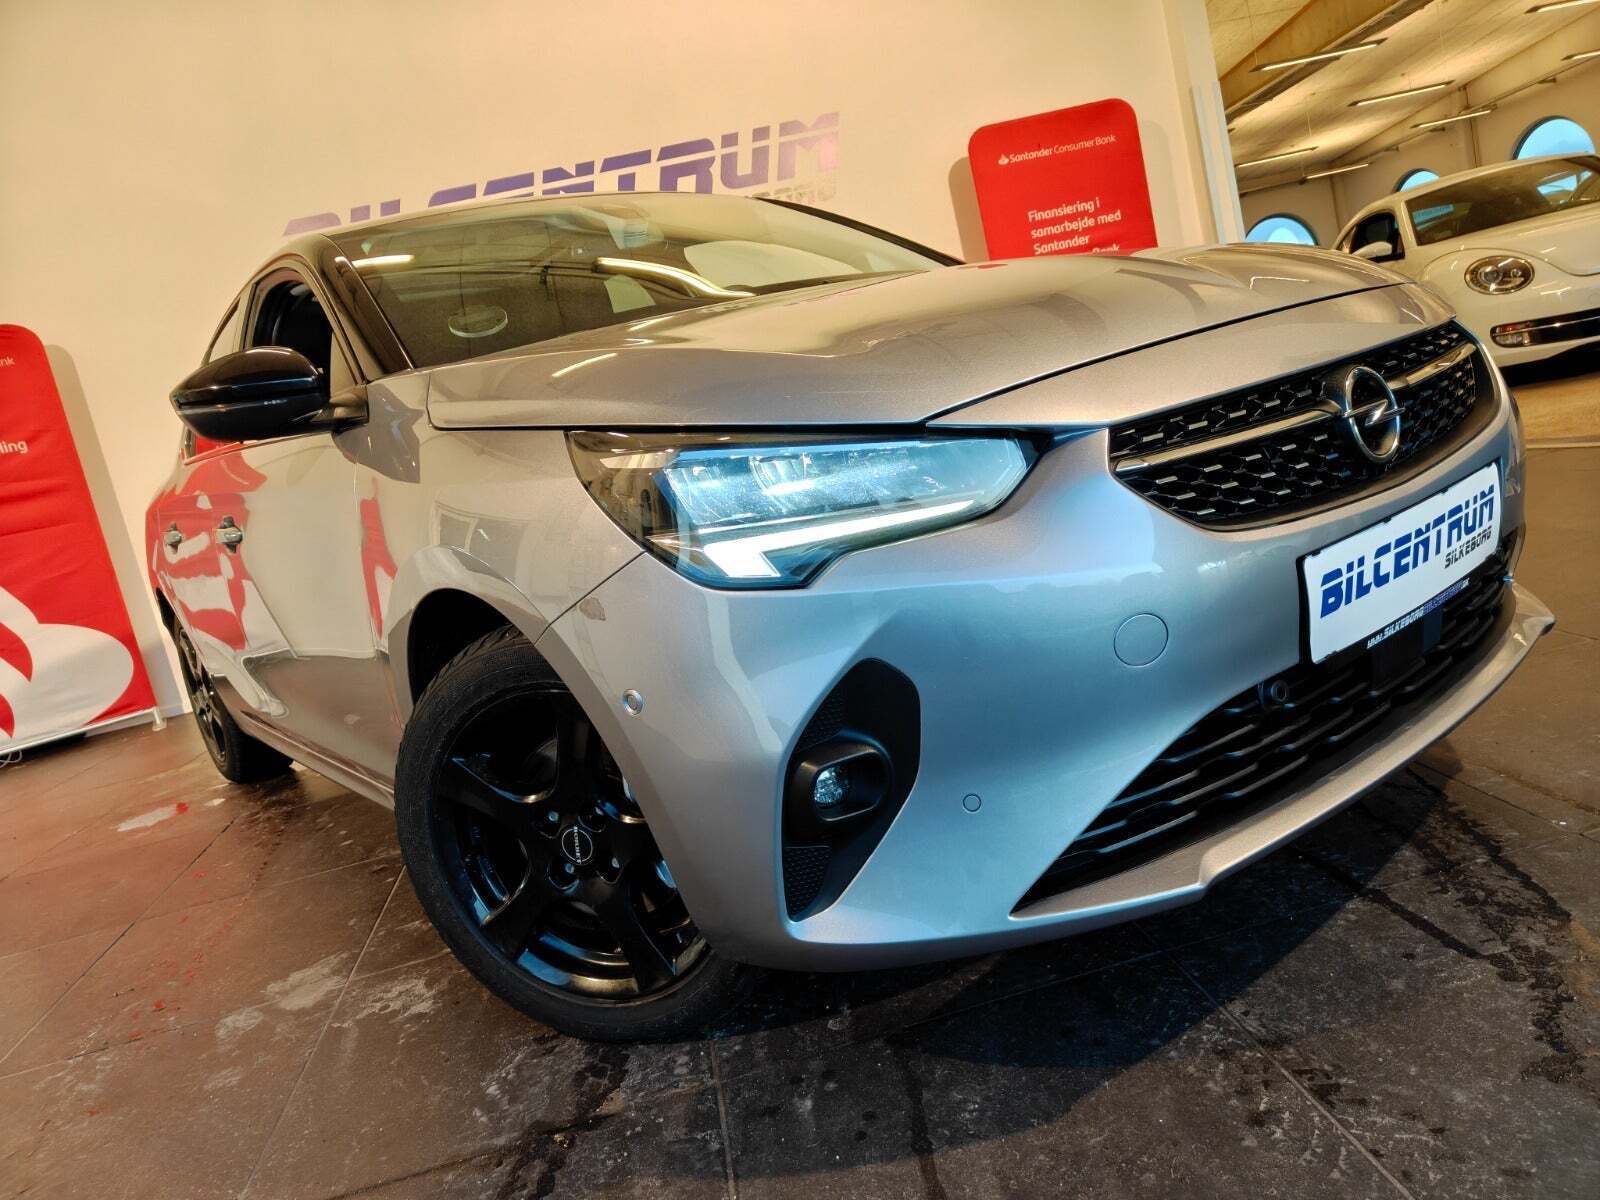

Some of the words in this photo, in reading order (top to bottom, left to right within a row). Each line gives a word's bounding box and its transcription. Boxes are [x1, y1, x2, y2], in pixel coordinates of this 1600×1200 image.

[1009, 147, 1053, 163] Santander
[1054, 139, 1094, 154] Consumer
[1095, 134, 1117, 146] Bank
[1027, 200, 1095, 222] Finansiering
[1095, 197, 1101, 208] i
[1031, 216, 1096, 239] samarbejde
[1097, 209, 1122, 225] med
[1033, 234, 1090, 255] Santander
[0, 356, 16, 367] nk
[0, 440, 28, 454] ling
[1320, 484, 1495, 619] BILCENTRUM
[1444, 525, 1493, 569] SILKEBORG
